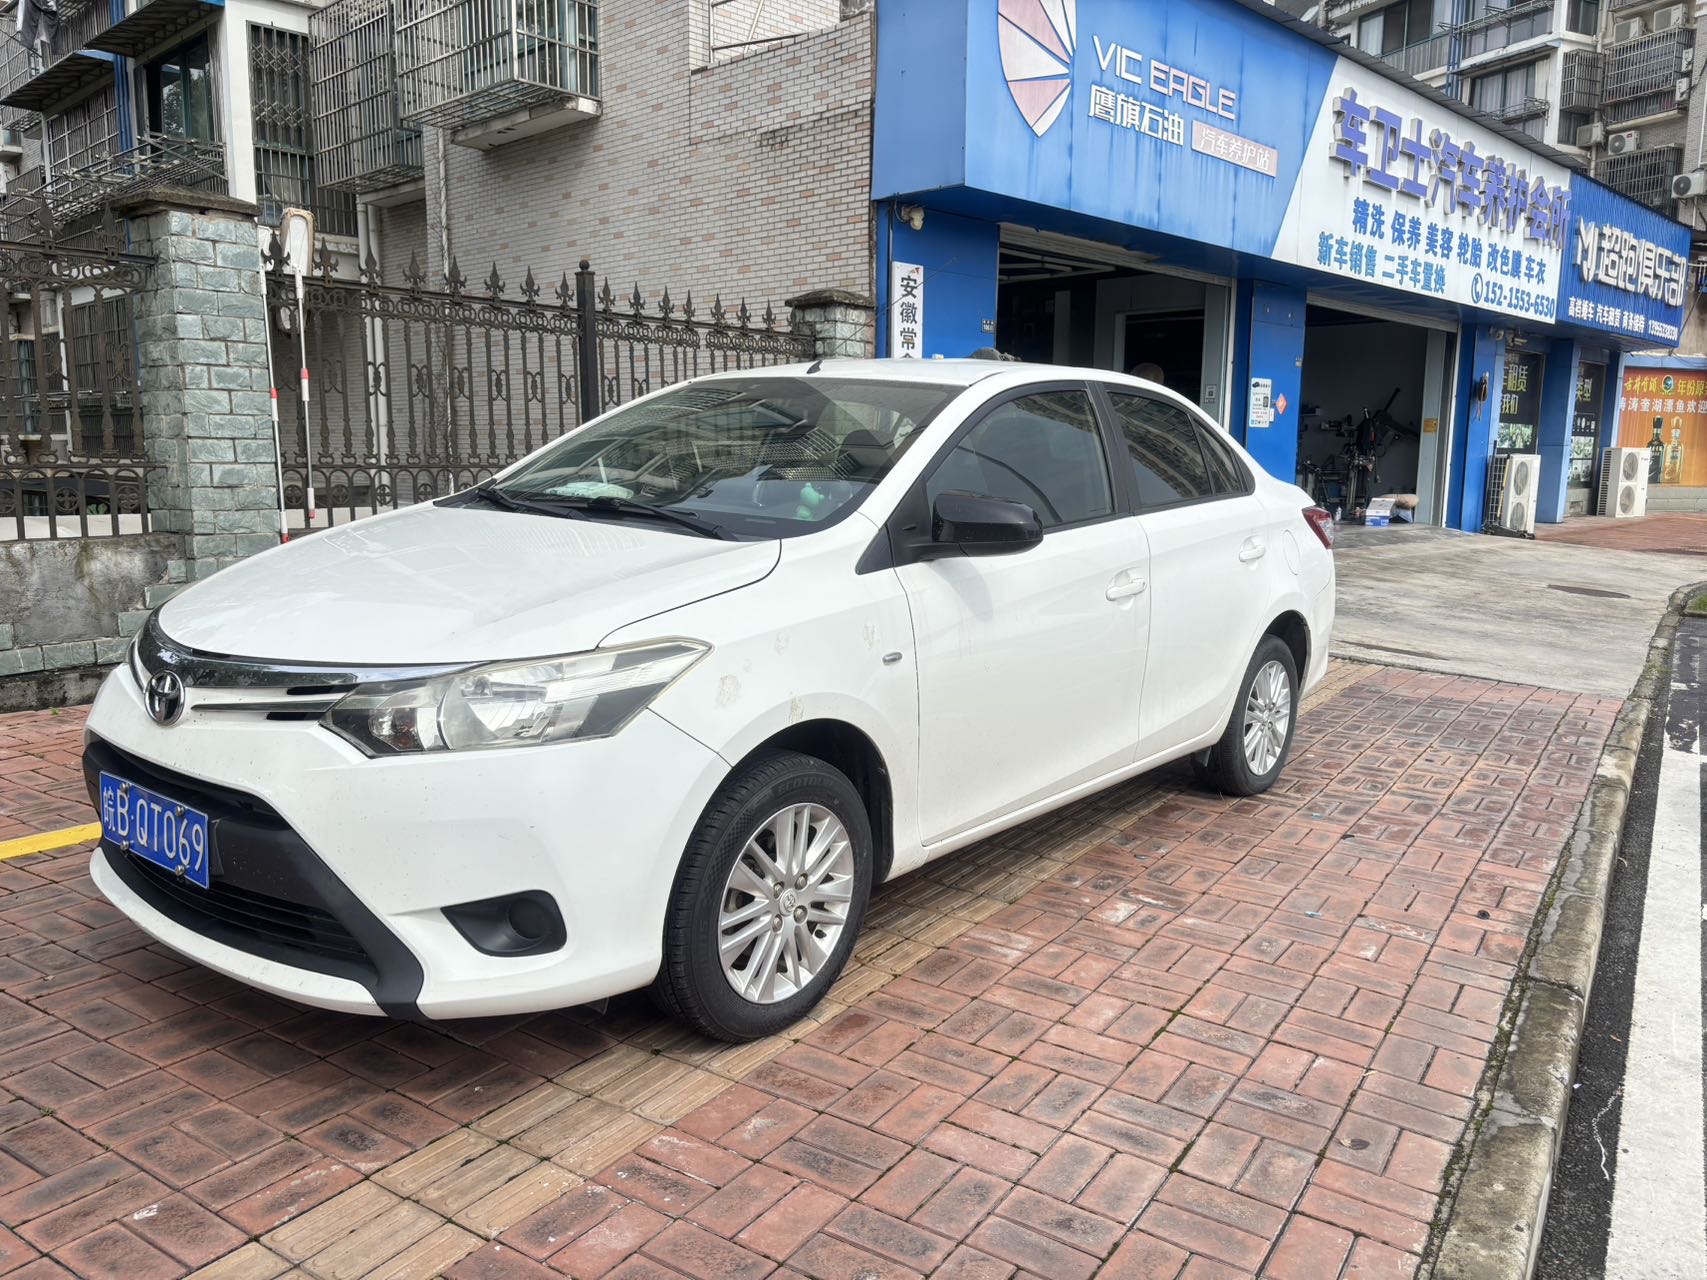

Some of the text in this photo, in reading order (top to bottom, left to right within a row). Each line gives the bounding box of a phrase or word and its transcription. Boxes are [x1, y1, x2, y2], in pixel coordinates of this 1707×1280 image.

[1093, 35, 1237, 121] VIC EAGLE
[1088, 84, 1184, 146] 鹰旗石油
[1200, 127, 1271, 171] 汽车养护站
[1329, 87, 1572, 250] 车卫士汽车养护会所
[1317, 231, 1446, 295] 新车销售 二手车置换
[1352, 196, 1546, 285] 精洗 保养 美容 轮胎 改色膜 车衣
[1599, 223, 1686, 307] 超跑俱乐部
[900, 275, 917, 358] 安徽常
[1484, 280, 1555, 319] 152-1553-6530
[1678, 379, 1707, 397] 年份原
